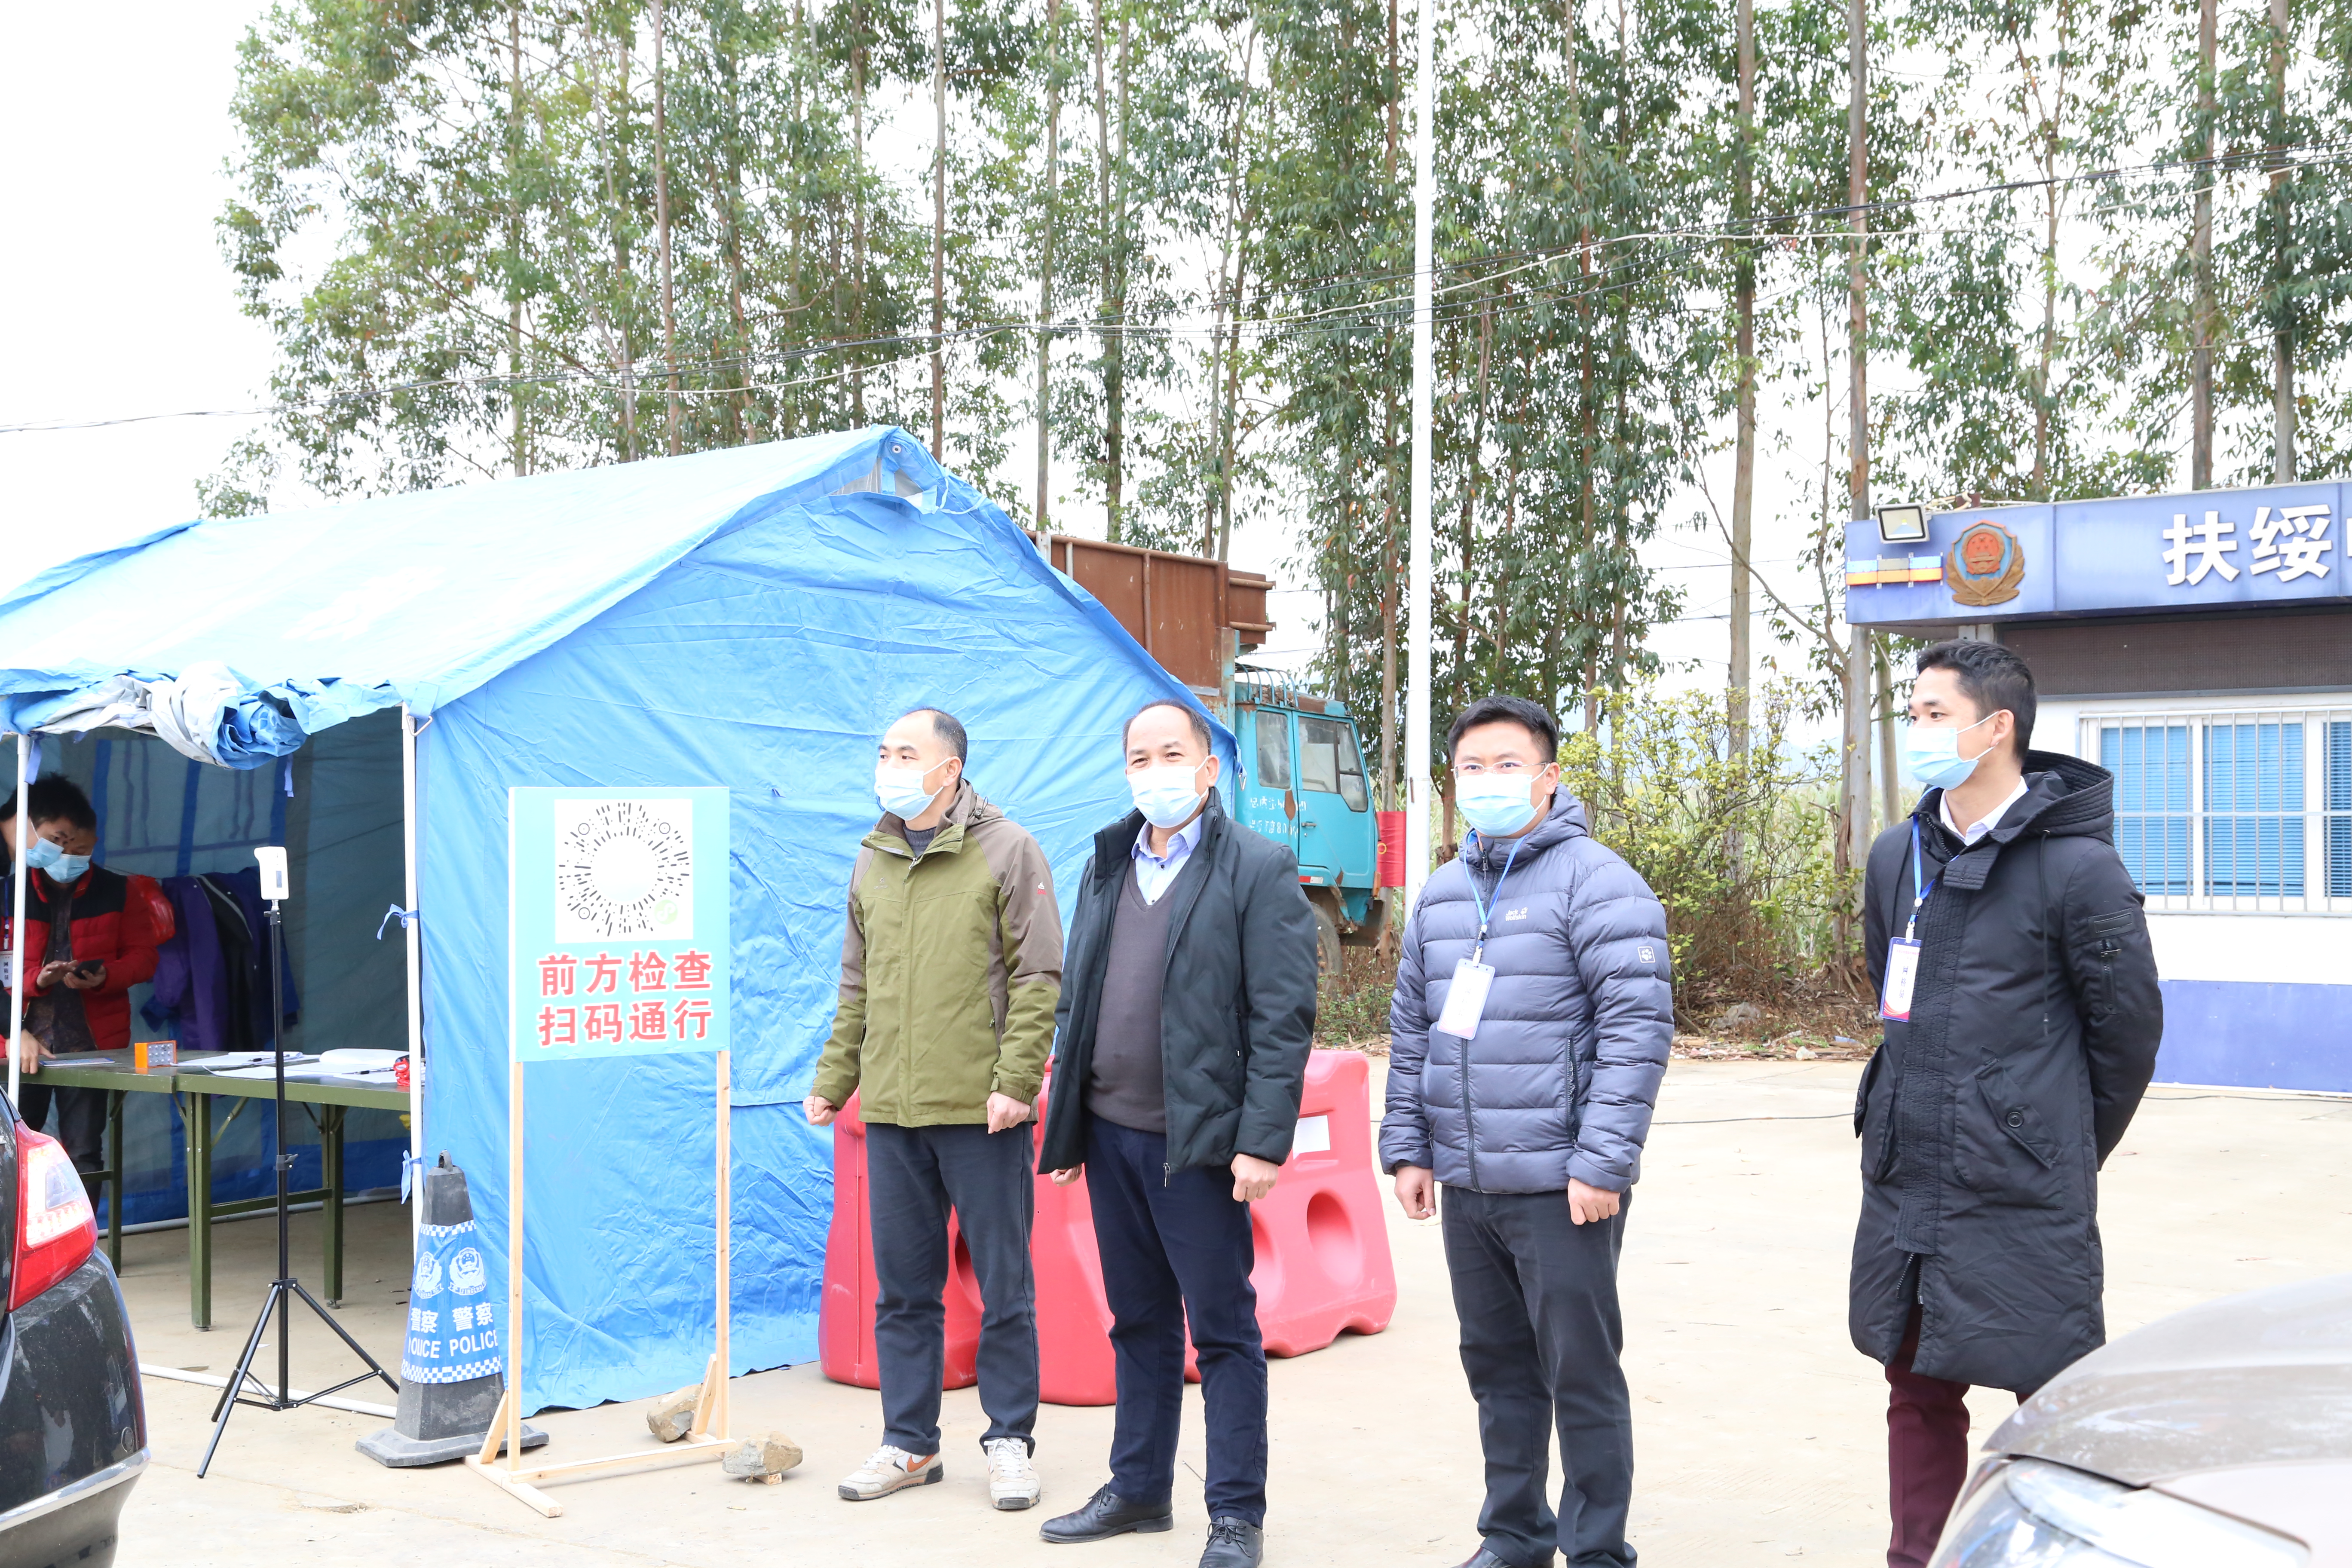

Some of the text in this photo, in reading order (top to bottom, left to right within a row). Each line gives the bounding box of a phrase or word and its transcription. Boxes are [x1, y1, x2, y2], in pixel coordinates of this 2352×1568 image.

[2162, 504, 2352, 586] 扶绥
[538, 950, 711, 996] 前方检查
[1899, 965, 1908, 999] 网格员
[538, 999, 712, 1046] 扫码通行
[461, 1285, 482, 1295] JINGCHA
[410, 1302, 493, 1333] 警察 警察
